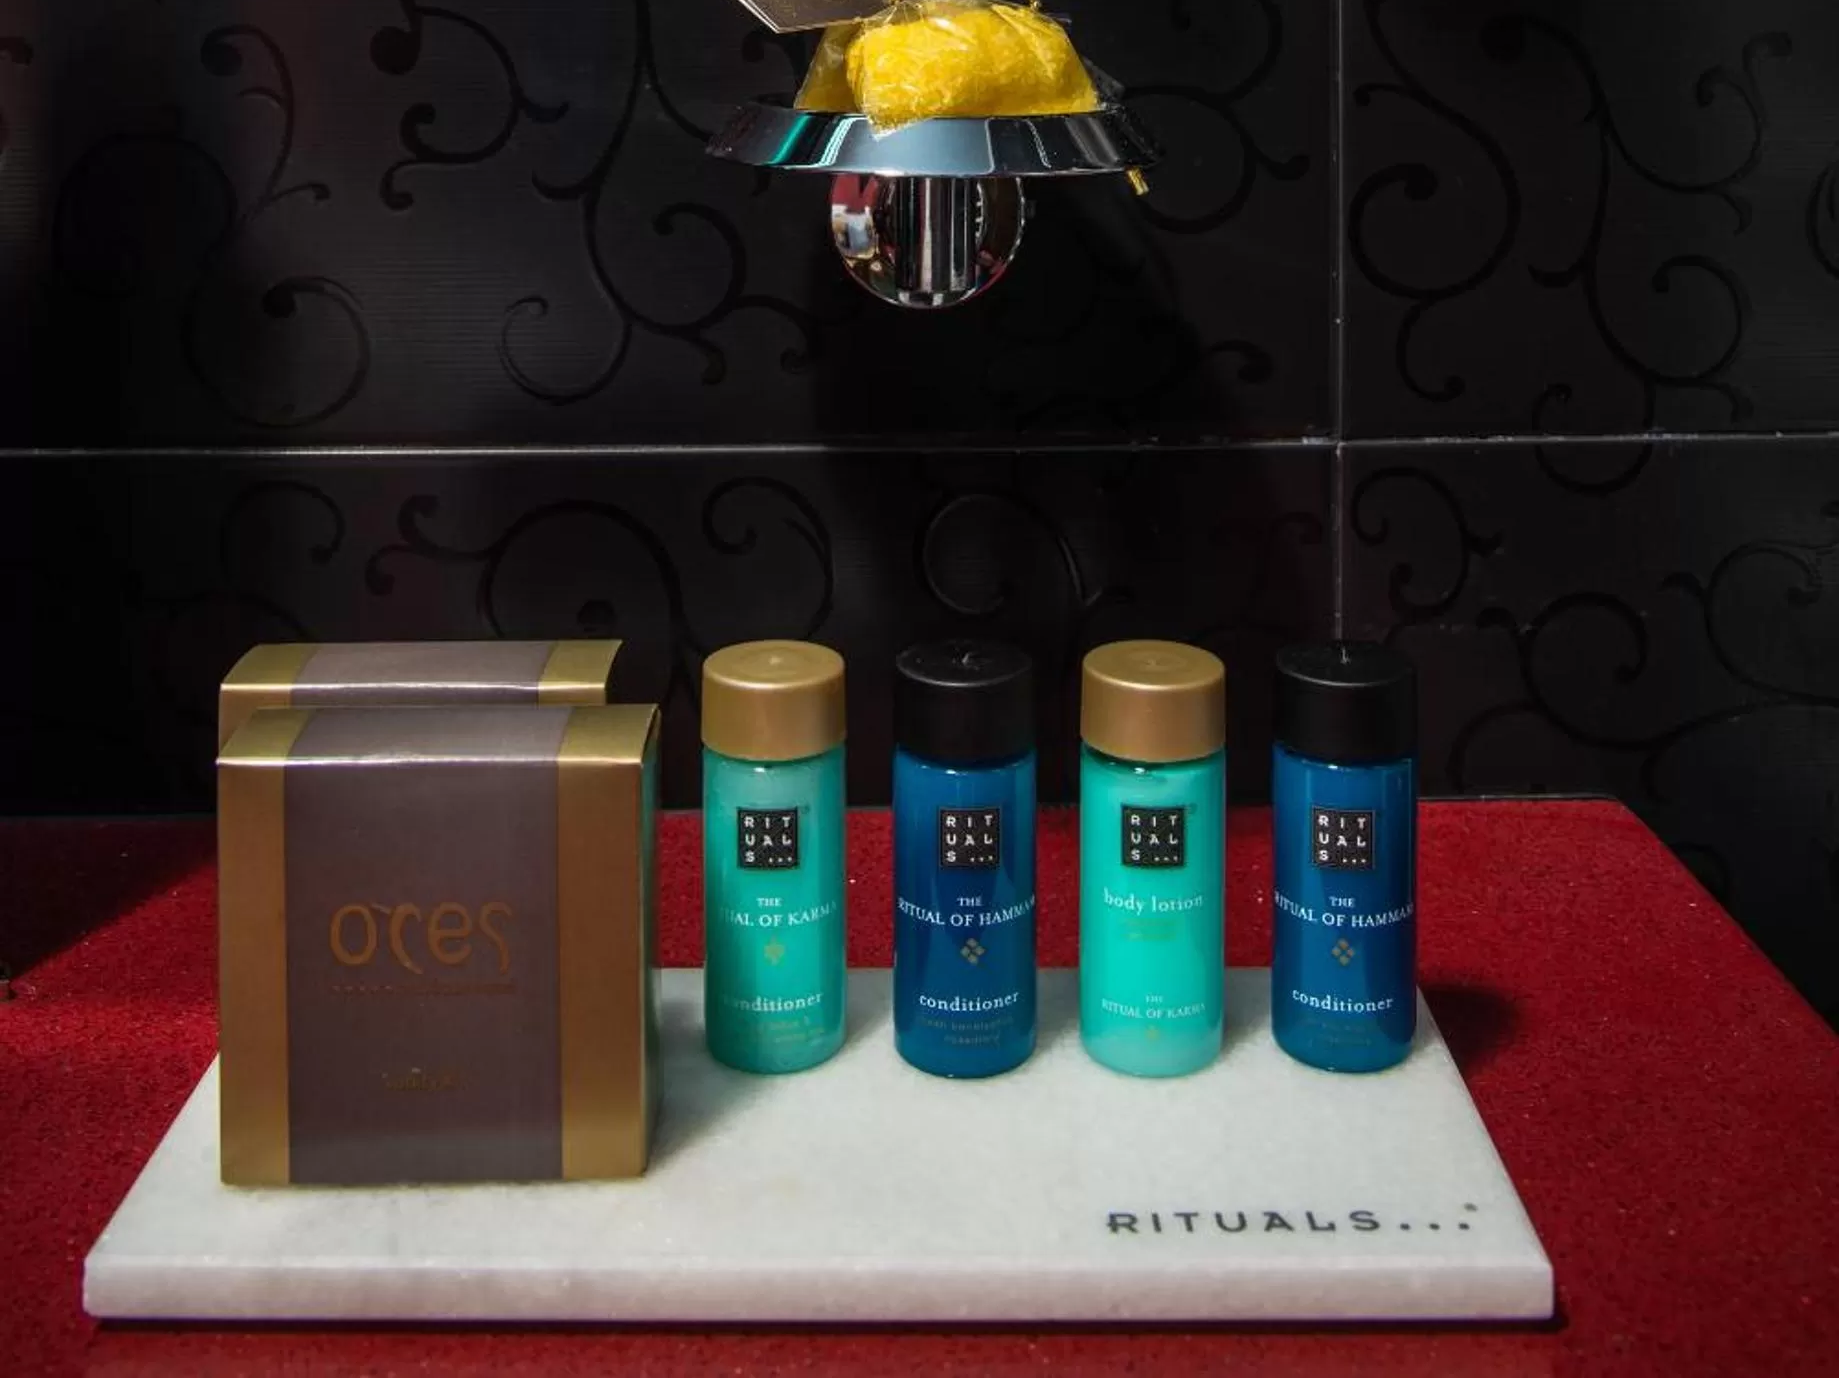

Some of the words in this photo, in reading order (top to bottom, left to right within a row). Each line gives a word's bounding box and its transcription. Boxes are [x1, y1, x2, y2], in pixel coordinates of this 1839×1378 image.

[757, 897, 782, 907] THE
[897, 896, 945, 925] RITUAL
[950, 914, 974, 926] OF
[957, 896, 983, 907] THE
[1103, 887, 1144, 915] body
[1151, 894, 1203, 913] lotion
[1329, 896, 1355, 908] THE
[758, 914, 783, 927] OF
[787, 900, 837, 926] KARMA
[1321, 913, 1346, 927] OF
[919, 992, 1020, 1013] conditioner
[1101, 998, 1143, 1019] RITUAL
[1145, 1008, 1163, 1019] OF
[1292, 989, 1394, 1013] conditioner
